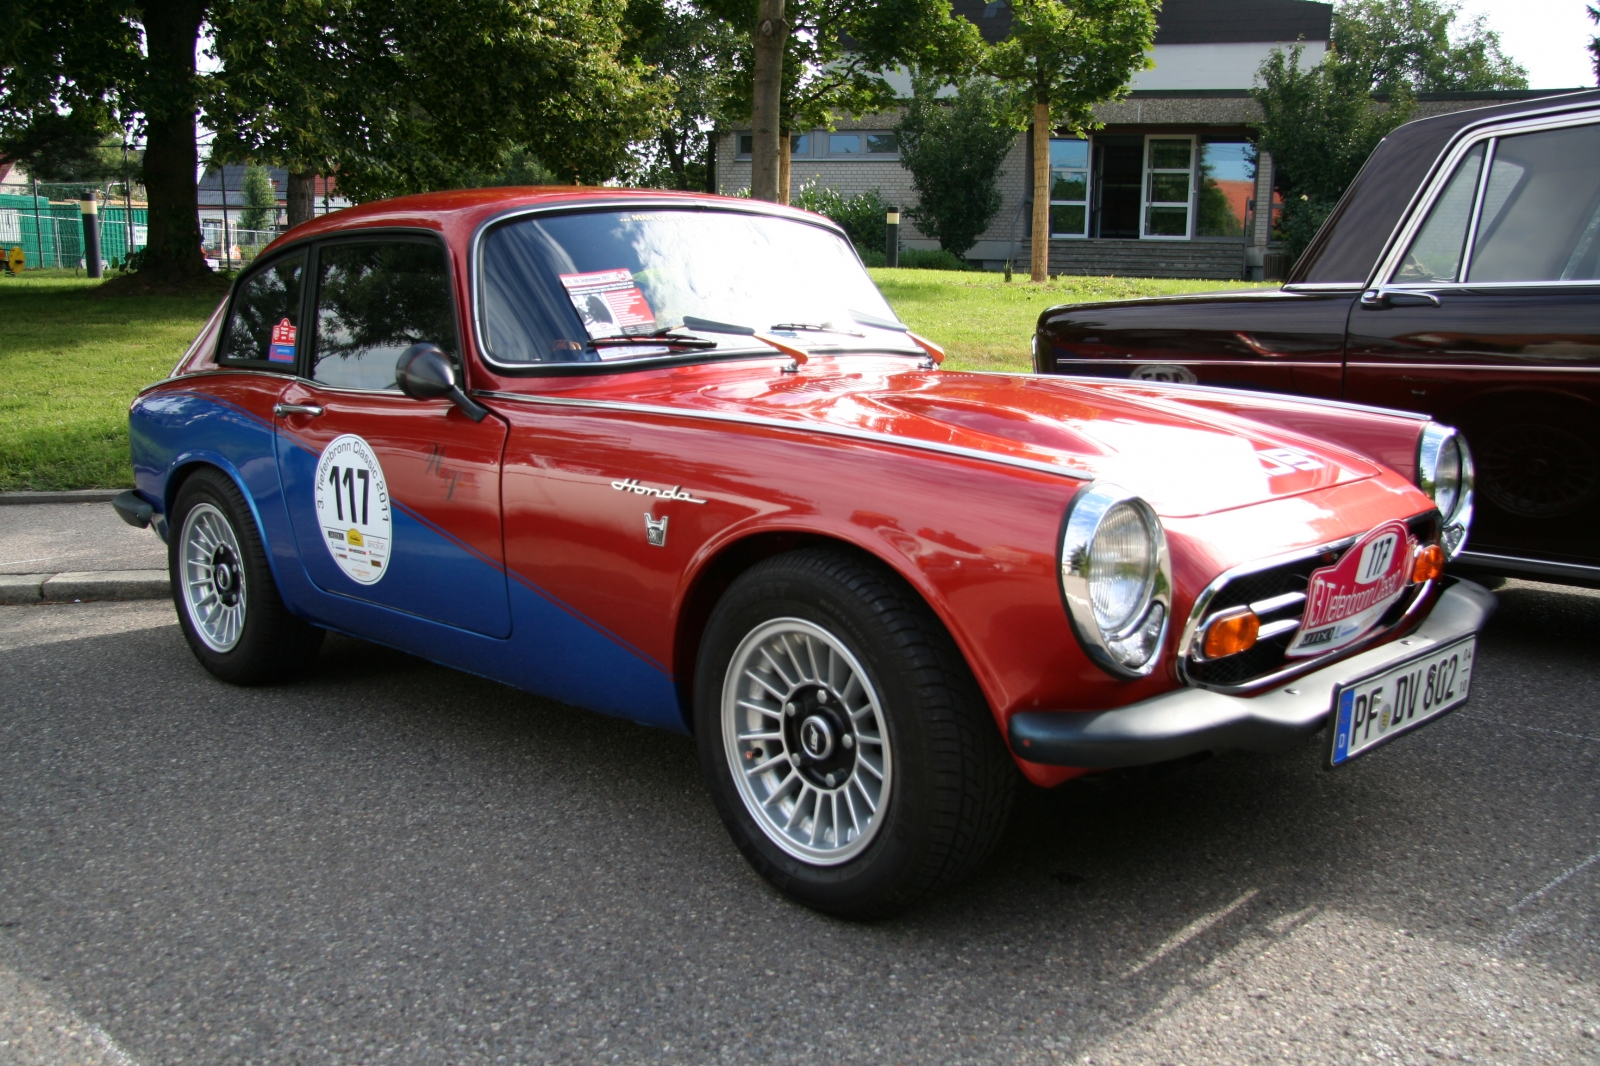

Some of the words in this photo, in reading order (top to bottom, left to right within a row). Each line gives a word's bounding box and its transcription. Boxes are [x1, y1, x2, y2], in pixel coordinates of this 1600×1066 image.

[631, 214, 653, 222] MAN
[316, 442, 351, 491] Tiefenbronn
[353, 441, 379, 479] Classic
[316, 497, 325, 509] 3.
[329, 465, 370, 526] 117
[376, 480, 389, 521] 2011
[611, 478, 707, 504] Honda
[1365, 537, 1393, 579] 117
[1320, 582, 1376, 625] Tiefenbronn
[1371, 568, 1401, 604] Classic
[818, 597, 870, 649] ROTATION
[1462, 647, 1472, 661] 04
[1351, 686, 1383, 747] PF
[1391, 669, 1422, 727] DV
[1422, 653, 1458, 711] 802
[1338, 733, 1346, 749] D
